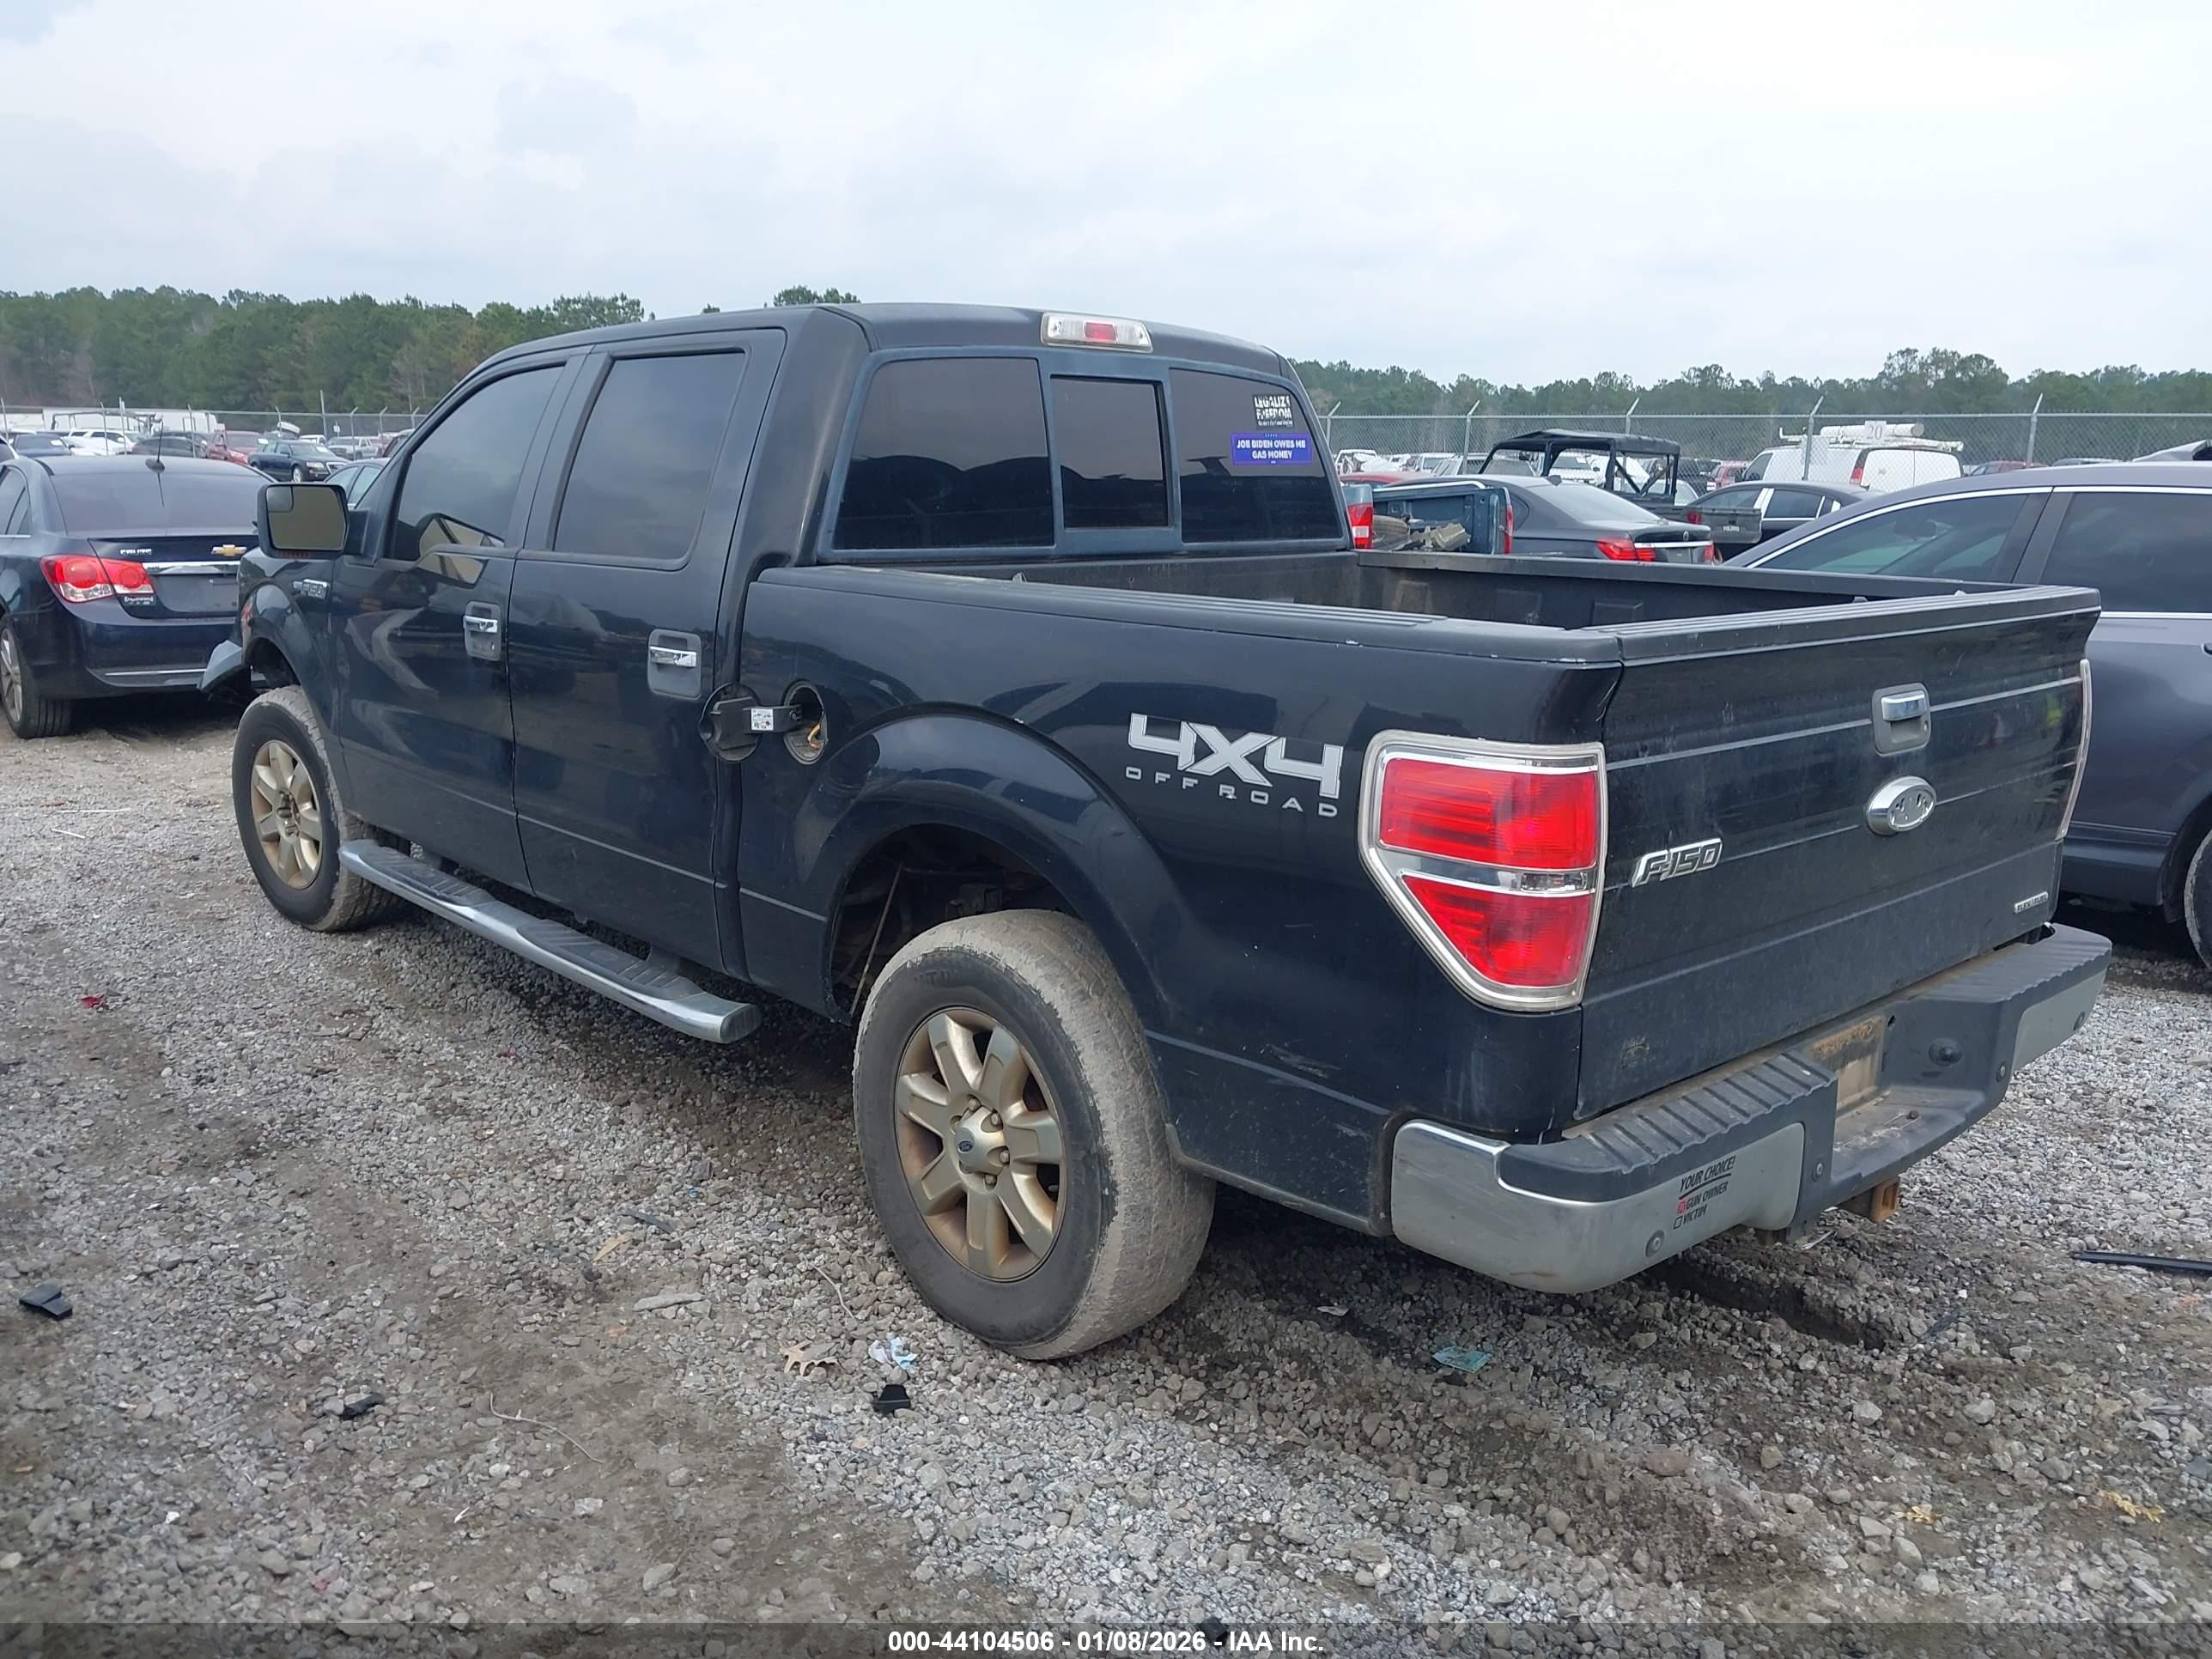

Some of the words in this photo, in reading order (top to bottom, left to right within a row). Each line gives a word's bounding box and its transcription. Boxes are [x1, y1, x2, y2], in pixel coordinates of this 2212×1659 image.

[1867, 425, 1883, 440] 20
[1237, 440, 1251, 449] JOE
[1251, 440, 1273, 449] BIDEN
[1273, 440, 1295, 449] OWES
[1295, 440, 1306, 449] ME
[1252, 450, 1267, 459] GAS
[1267, 450, 1292, 459] MONEY
[1125, 765, 1199, 790] OFF
[1218, 783, 1338, 817] ROAD
[1680, 1170, 1704, 1193] YOUR
[1704, 1155, 1736, 1180] CHOICE!
[1686, 1194, 1702, 1210] GUN
[1702, 1182, 1729, 1203] OWNER
